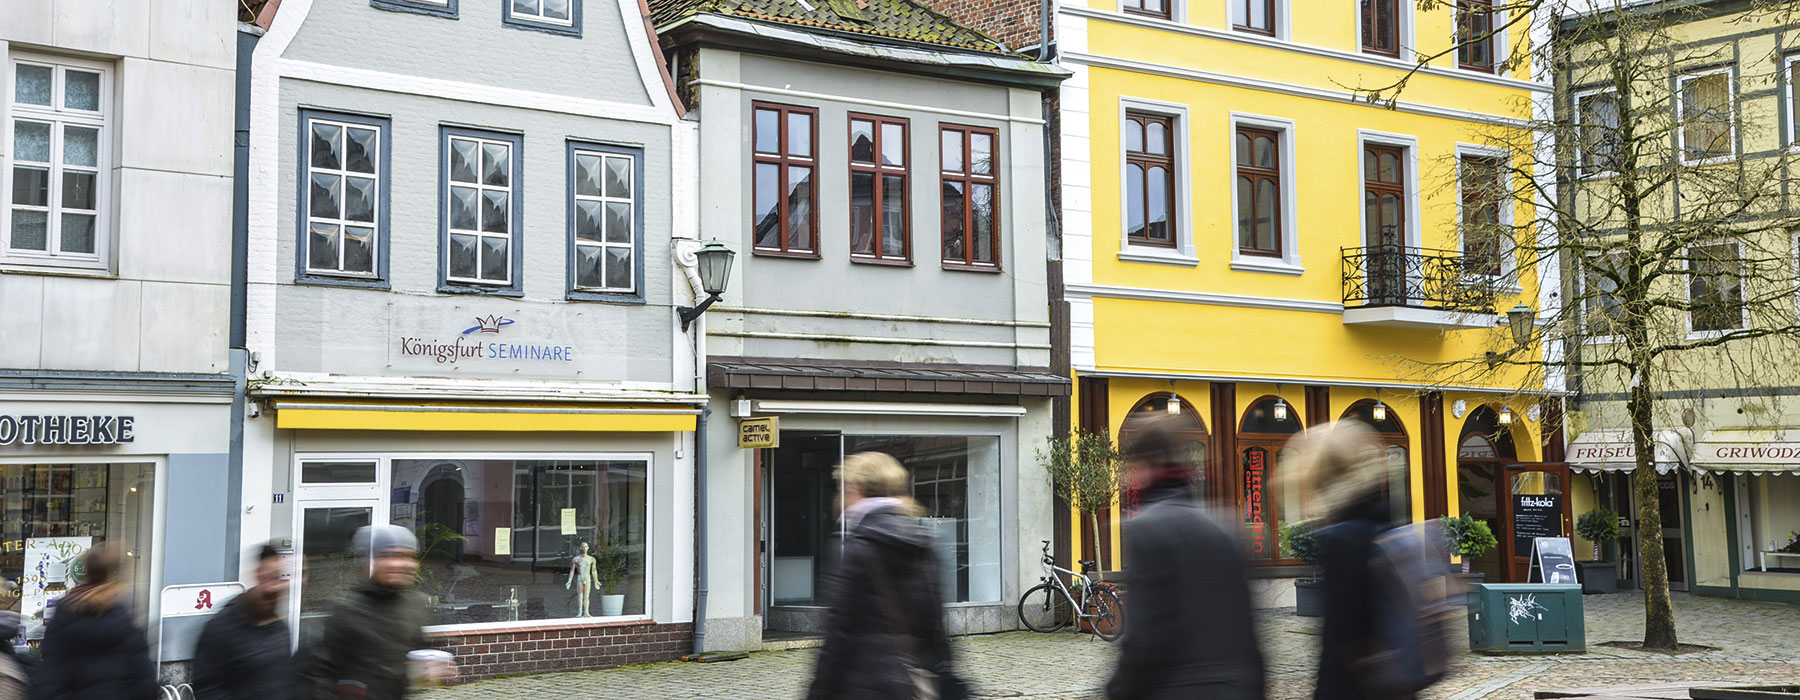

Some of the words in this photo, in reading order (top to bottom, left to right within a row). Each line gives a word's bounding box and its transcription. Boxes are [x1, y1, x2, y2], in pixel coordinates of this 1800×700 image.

[401, 336, 483, 363] Königsfurt
[488, 343, 572, 361] SEMINARE
[743, 424, 769, 433] camel
[743, 433, 770, 442] active
[1576, 447, 1637, 458] FRISEU
[1701, 475, 1713, 490] 14
[273, 493, 284, 504] 11
[1521, 496, 1553, 508] fritz-kola
[0, 538, 88, 556] TER-APO
